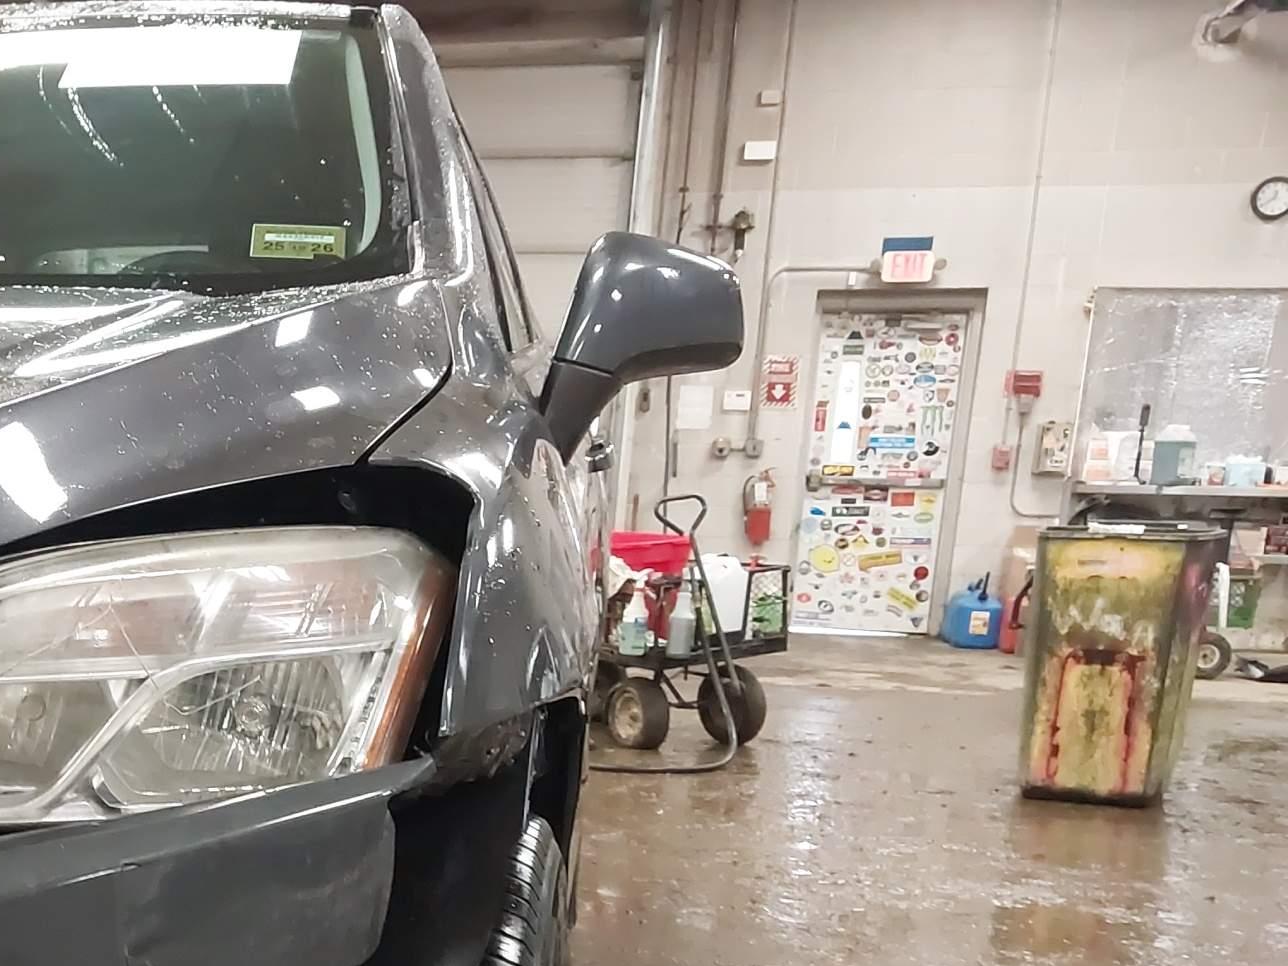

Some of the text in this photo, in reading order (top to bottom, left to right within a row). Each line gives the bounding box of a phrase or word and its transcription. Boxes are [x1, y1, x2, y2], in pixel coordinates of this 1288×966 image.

[263, 242, 285, 251] 25
[311, 243, 334, 253] 26
[890, 252, 928, 280] EXIT
